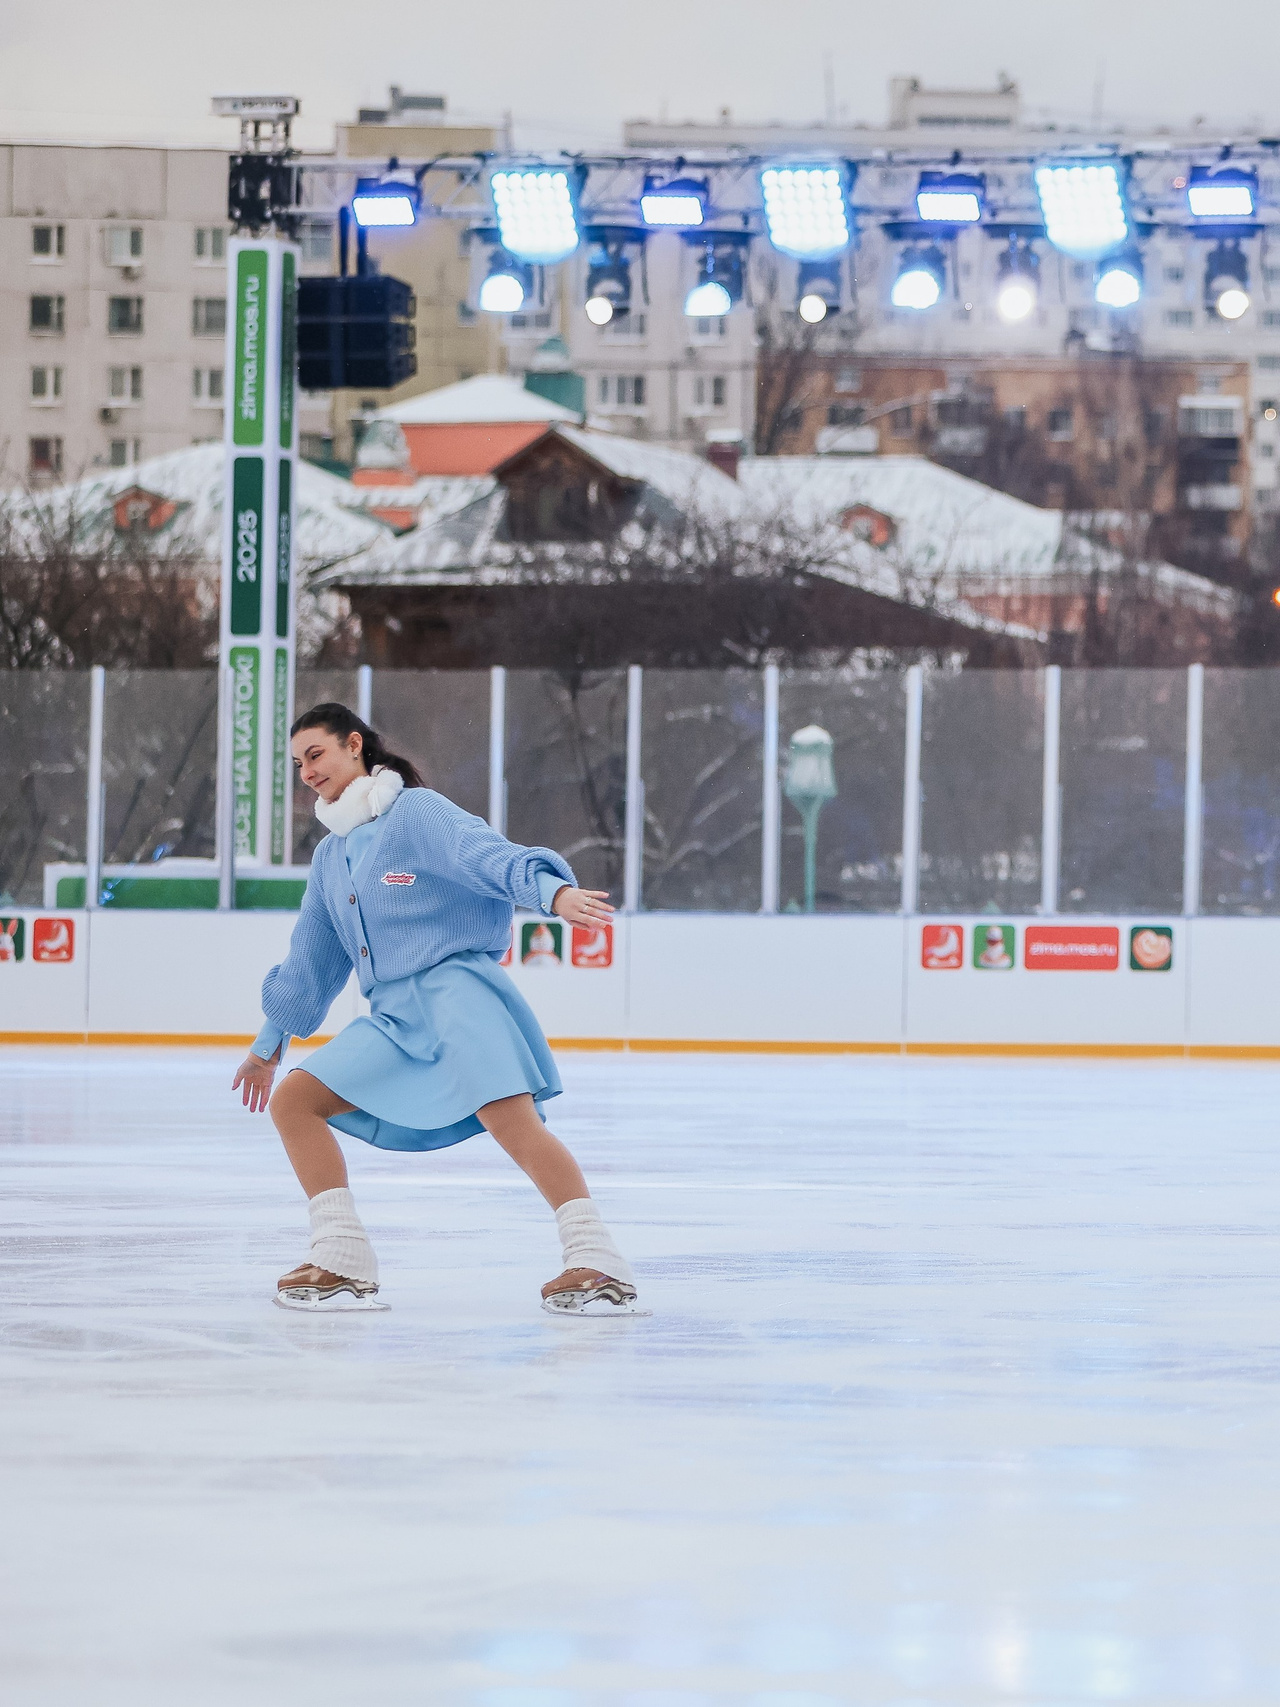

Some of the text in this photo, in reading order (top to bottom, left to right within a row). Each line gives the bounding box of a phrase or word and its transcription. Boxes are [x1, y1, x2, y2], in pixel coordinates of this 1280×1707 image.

[238, 274, 260, 420] zima.mos.ru
[236, 508, 258, 583] 2025
[233, 757, 252, 795] НА
